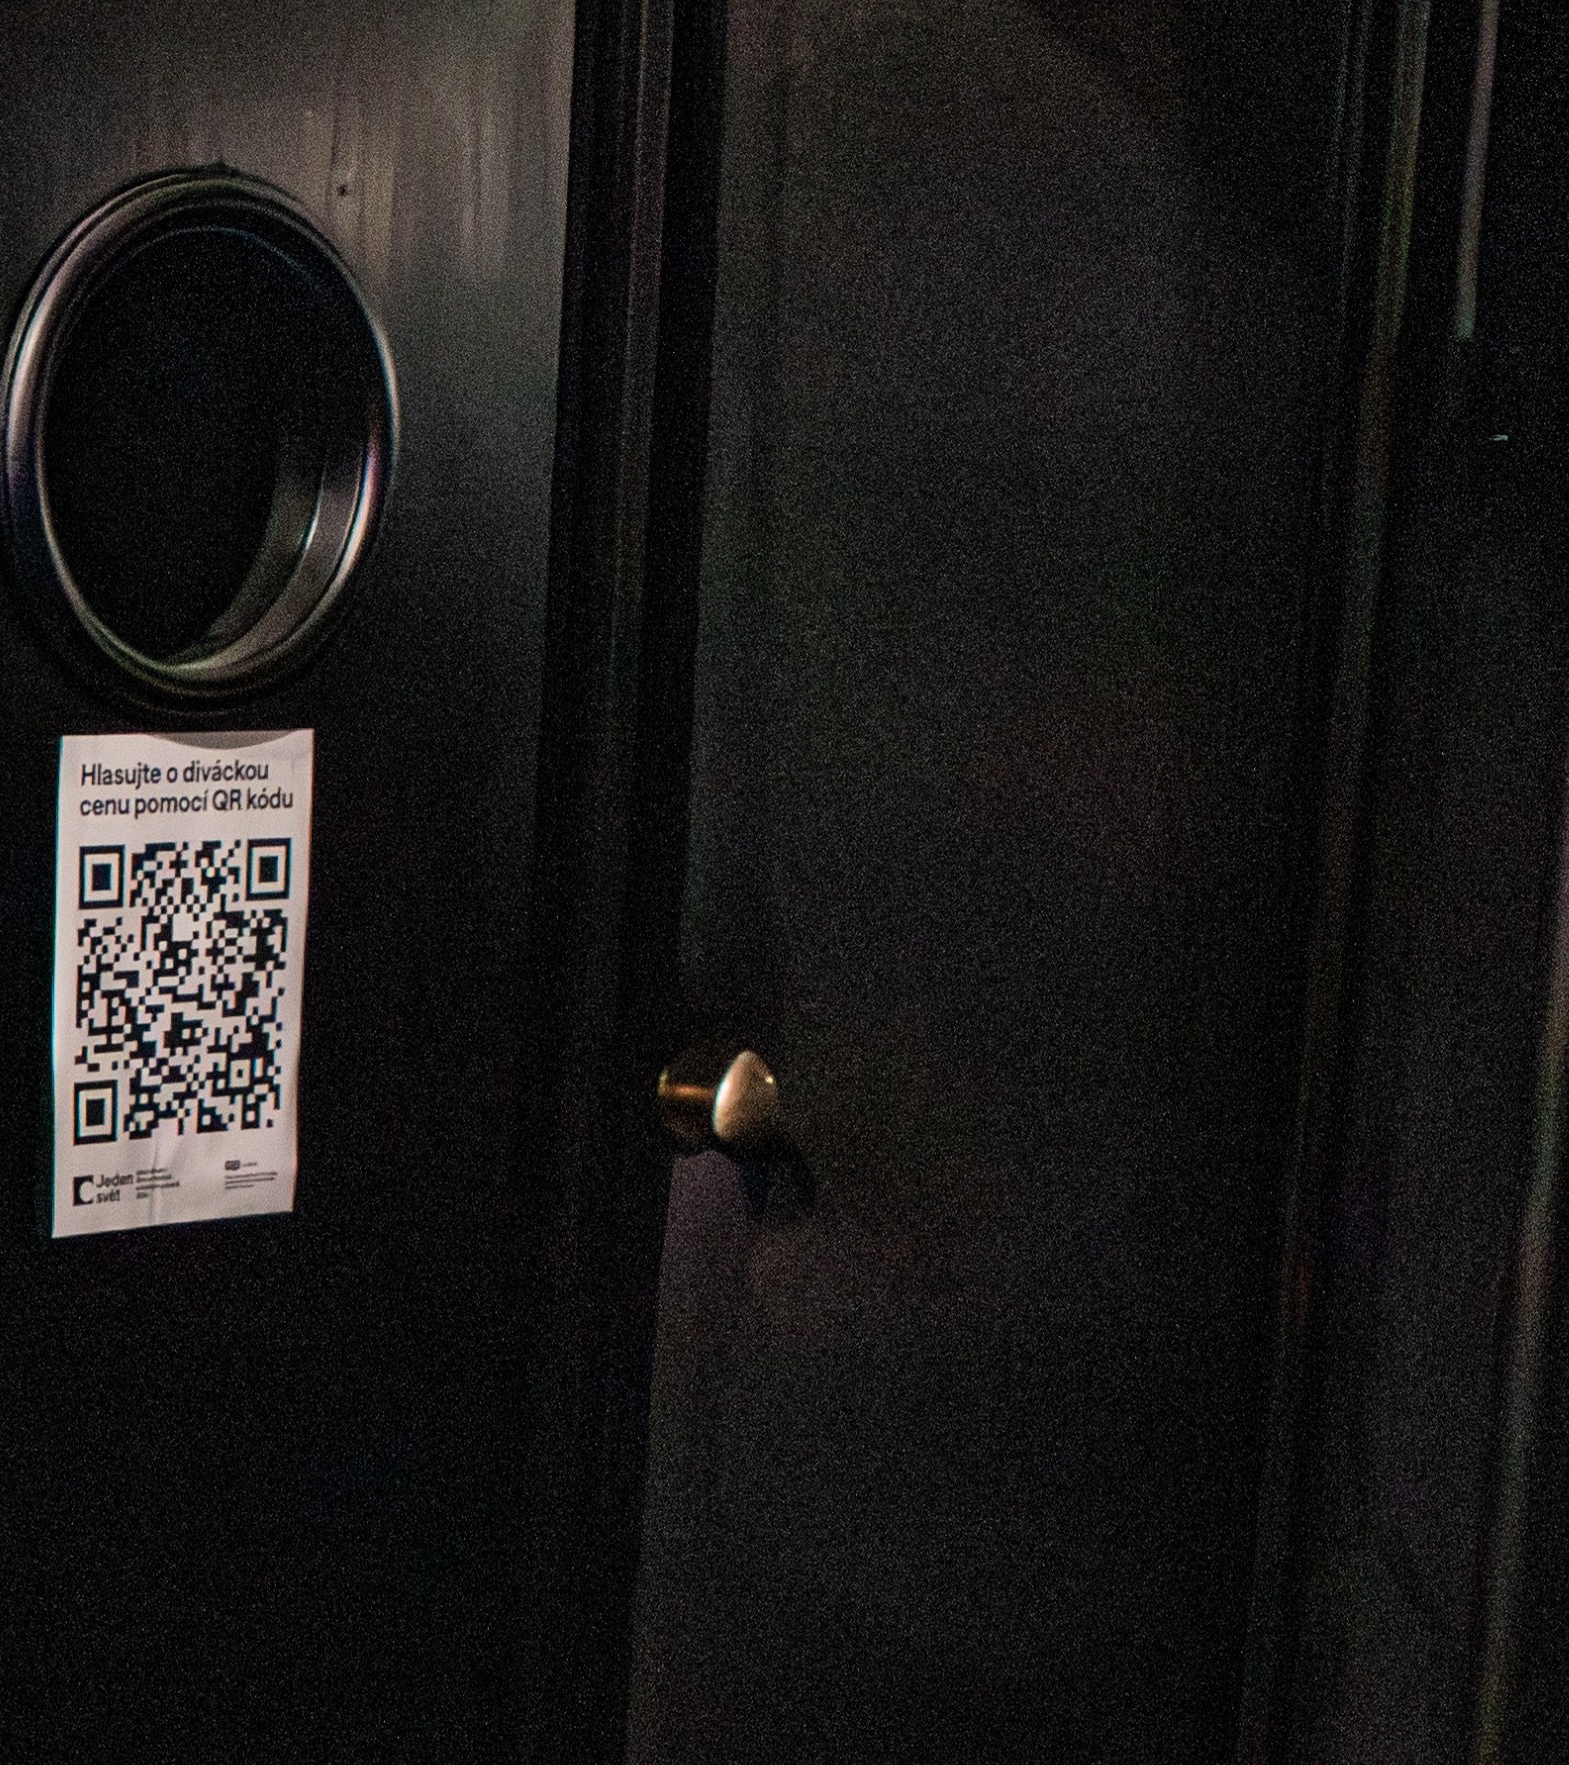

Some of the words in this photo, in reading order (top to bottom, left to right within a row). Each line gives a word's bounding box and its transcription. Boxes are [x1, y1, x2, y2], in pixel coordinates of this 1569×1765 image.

[81, 762, 162, 789] Hlasujte
[166, 767, 178, 783] o
[183, 760, 269, 784] diváckou
[80, 798, 130, 816] cenu
[134, 789, 209, 820] pomocí
[212, 789, 242, 811] QR
[246, 787, 294, 810] kódu
